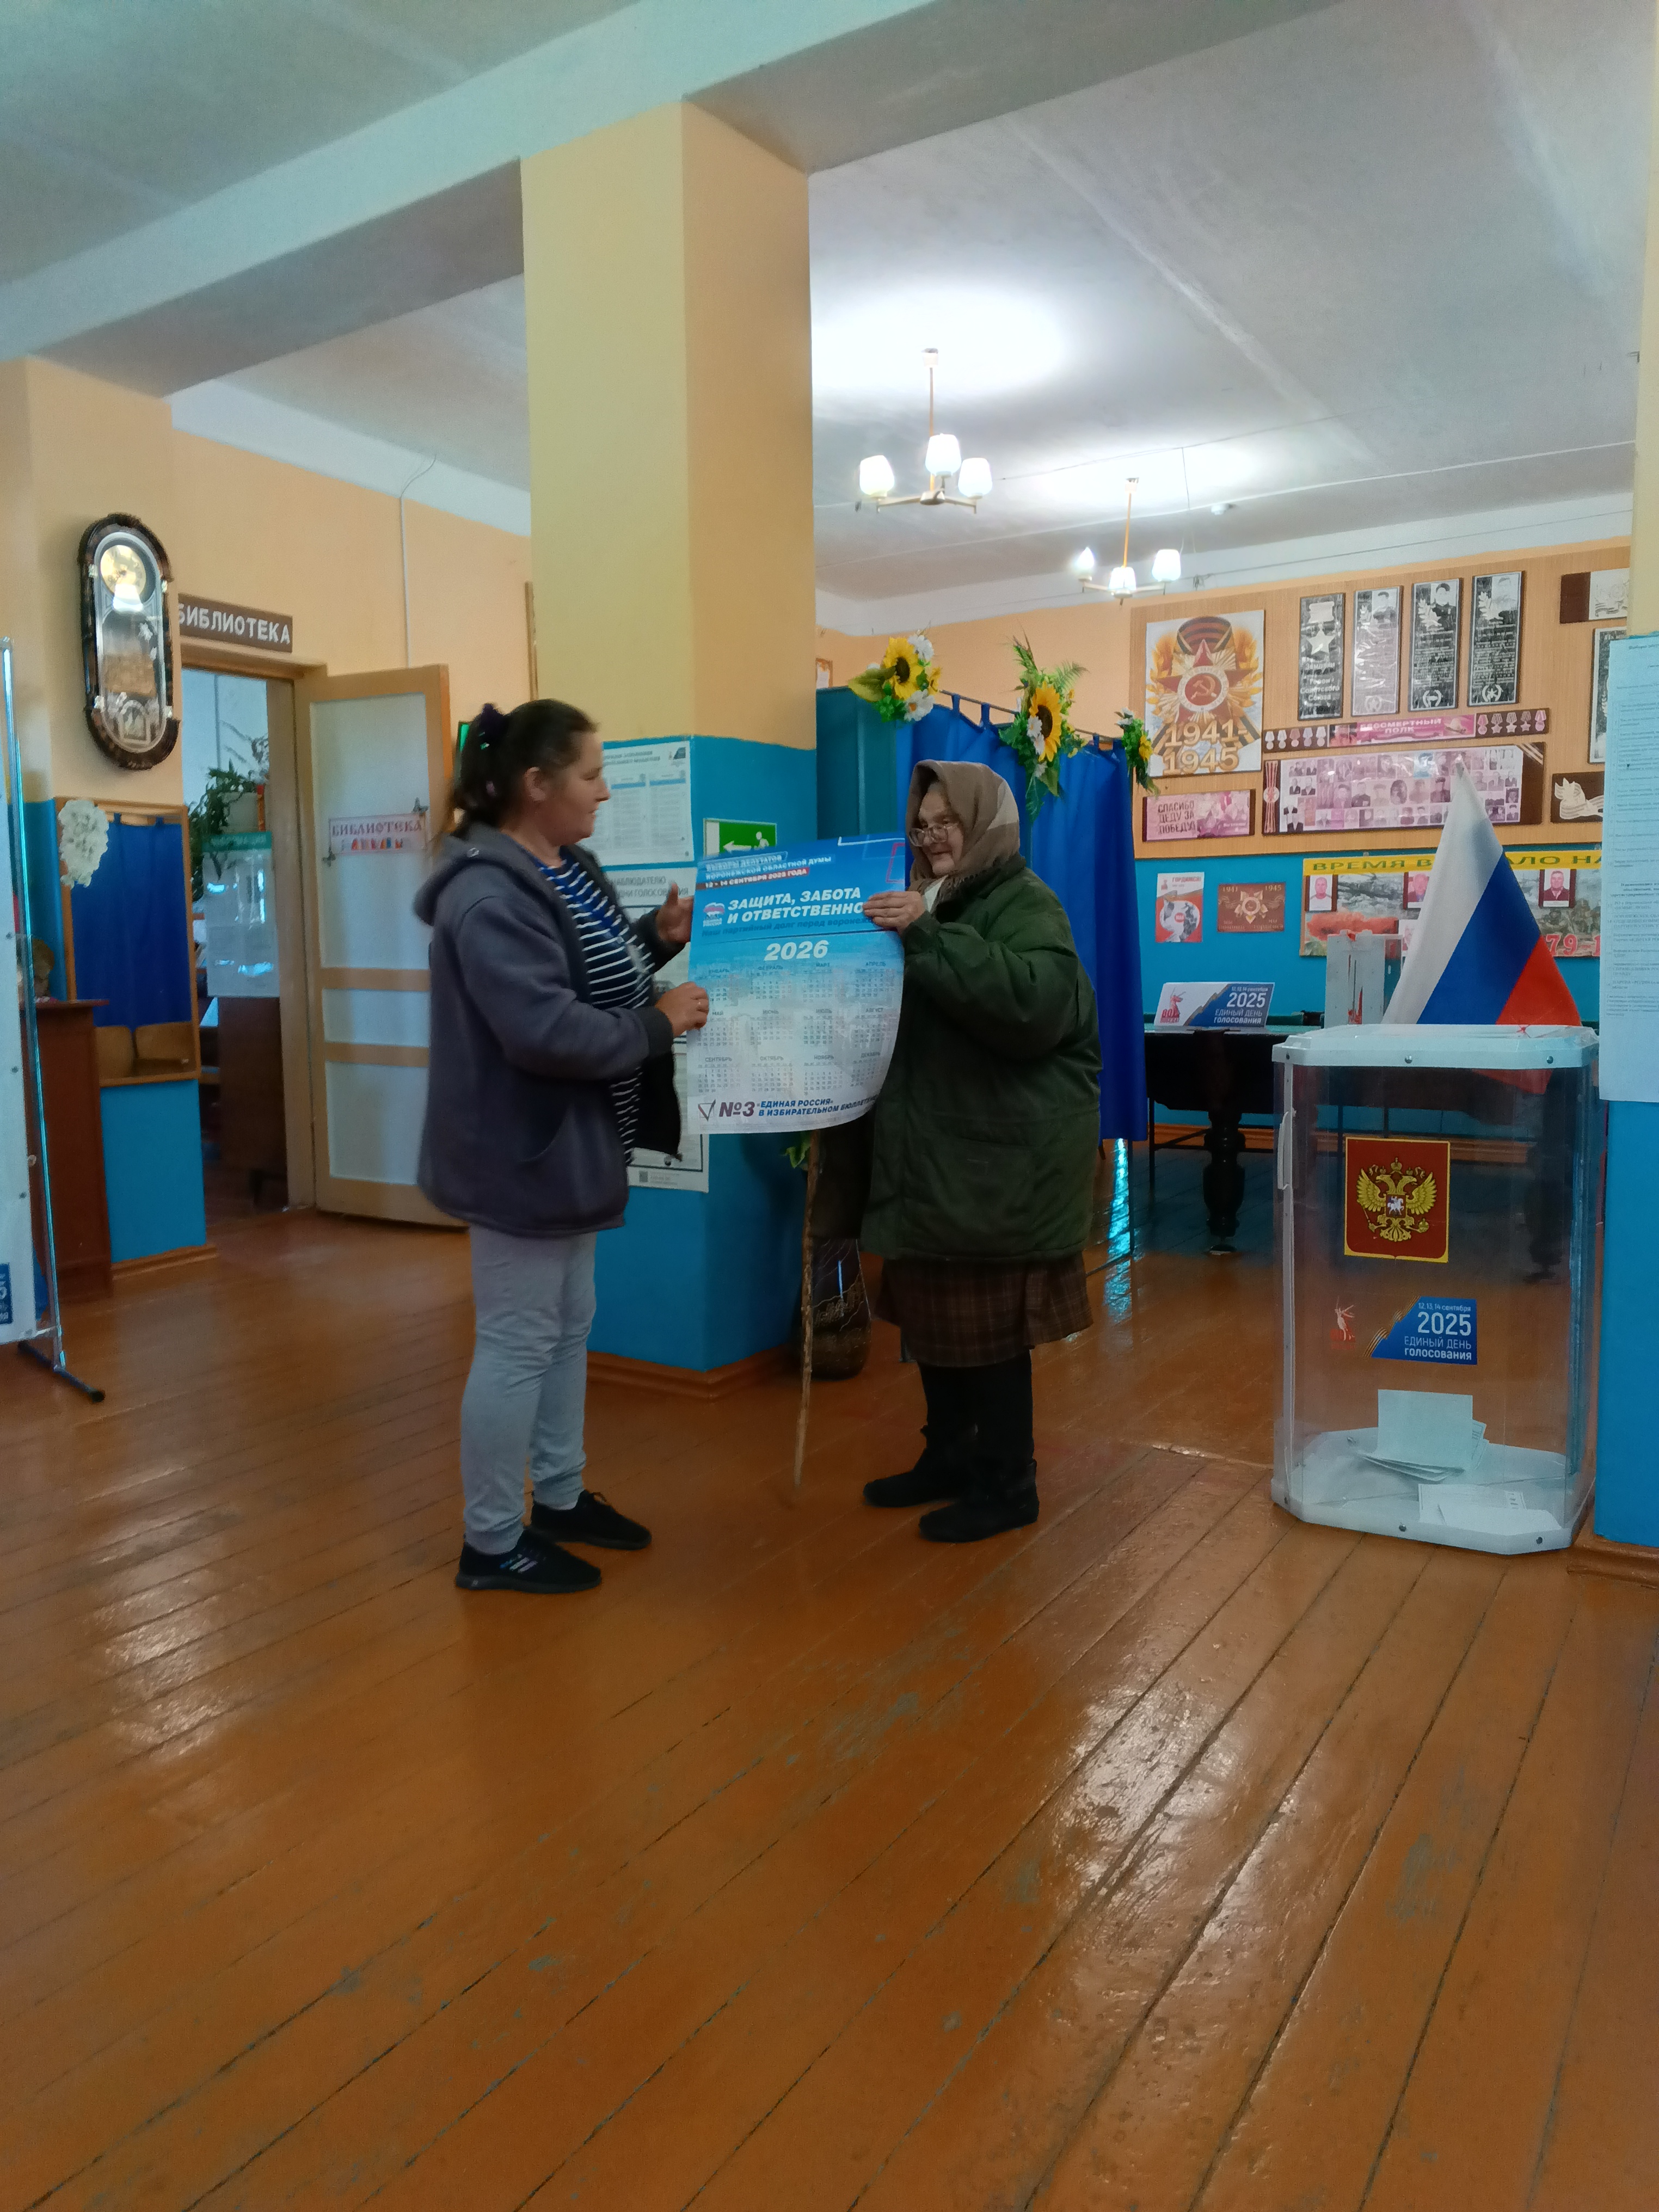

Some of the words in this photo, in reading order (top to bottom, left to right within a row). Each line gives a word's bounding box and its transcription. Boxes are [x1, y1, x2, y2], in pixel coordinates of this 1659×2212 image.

[179, 603, 291, 644] БИБЛИОТЕКА
[1163, 746, 1239, 775] 1945
[1158, 800, 1195, 813] СПАСИБО
[1159, 812, 1182, 824] ДЕДУ
[1184, 810, 1195, 820] ЗА
[788, 868, 807, 877] ГОДА
[1313, 860, 1405, 871] ВРЕМЯ
[635, 887, 689, 898] ГОЛОСОВИЯ
[727, 893, 796, 911] ЗАЩИТА,
[800, 887, 861, 902] ЗАБОТА
[727, 913, 738, 924] И
[742, 902, 863, 922] ОТВЕТСТВЕННО
[797, 919, 825, 929] перед
[764, 940, 828, 961] 2026
[1226, 992, 1267, 1008] 2025
[1215, 1007, 1244, 1016] ЕДИНЫЙ
[719, 1102, 755, 1117] №3
[767, 1104, 839, 1116] ИЗБИРАТЕЛЬНОМ
[1417, 1311, 1472, 1336] 2025
[1404, 1336, 1443, 1347] ЕДИНЫЙ
[1446, 1339, 1472, 1350] ДЕНЬ
